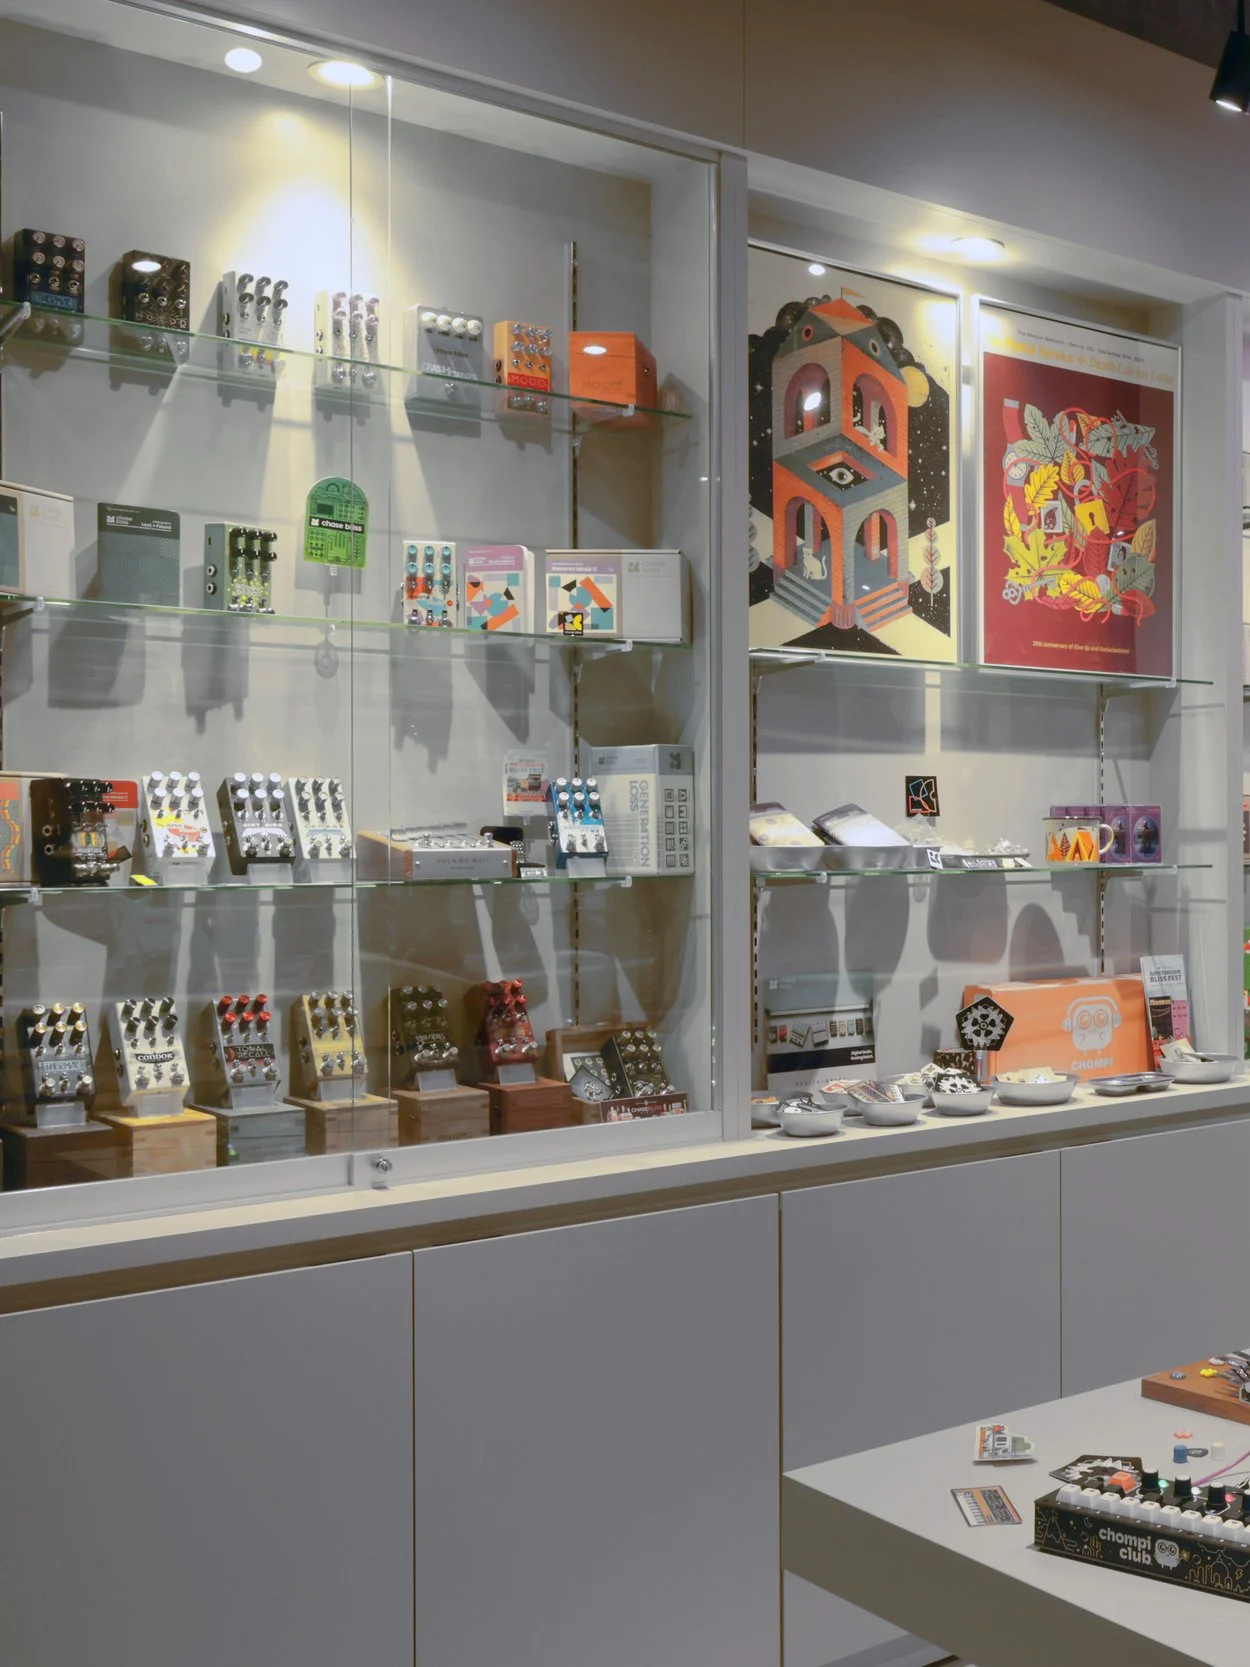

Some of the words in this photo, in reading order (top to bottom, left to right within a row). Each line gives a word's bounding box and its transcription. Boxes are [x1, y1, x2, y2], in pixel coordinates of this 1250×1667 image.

[511, 375, 547, 386] MOOD
[321, 520, 344, 529] chase
[344, 523, 363, 532] bliss
[629, 780, 639, 812] LOSS
[639, 780, 650, 868] GENERATION
[1150, 975, 1167, 983] BLISS
[1167, 974, 1182, 982] FEST
[236, 1044, 266, 1052] TONAL
[237, 1050, 272, 1059] RECALL
[1098, 1527, 1152, 1551] chompi
[1119, 1547, 1152, 1566] club
